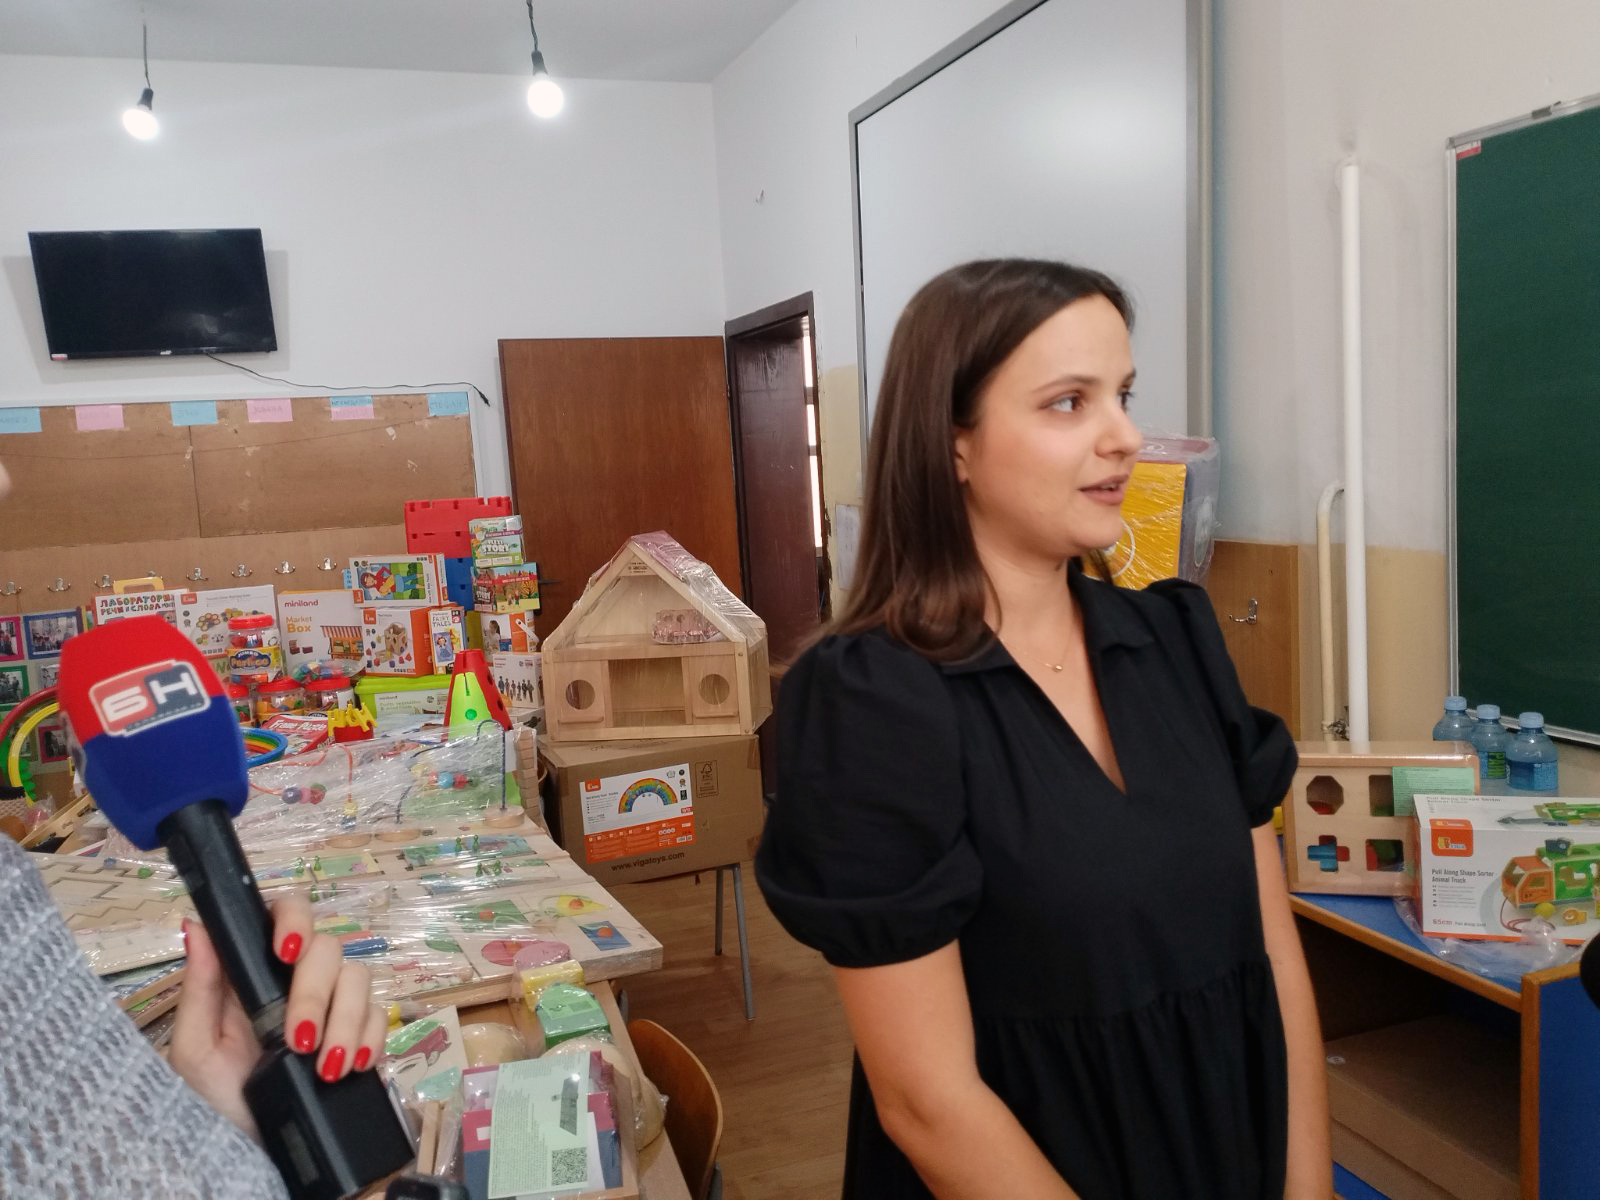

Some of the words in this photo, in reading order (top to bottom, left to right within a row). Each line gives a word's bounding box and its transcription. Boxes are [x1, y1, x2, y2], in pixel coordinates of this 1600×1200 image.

[481, 544, 510, 553] STORY
[130, 601, 161, 612] СЛОВА
[284, 599, 319, 607] miniland
[285, 616, 312, 624] Market
[287, 624, 312, 633] Box
[269, 719, 298, 729] Frame
[298, 721, 327, 731] Puzzle
[611, 852, 685, 871] www.vigatoys.com
[1431, 868, 1443, 876] Pull
[1444, 869, 1459, 877] Along
[1459, 869, 1476, 877] Shape
